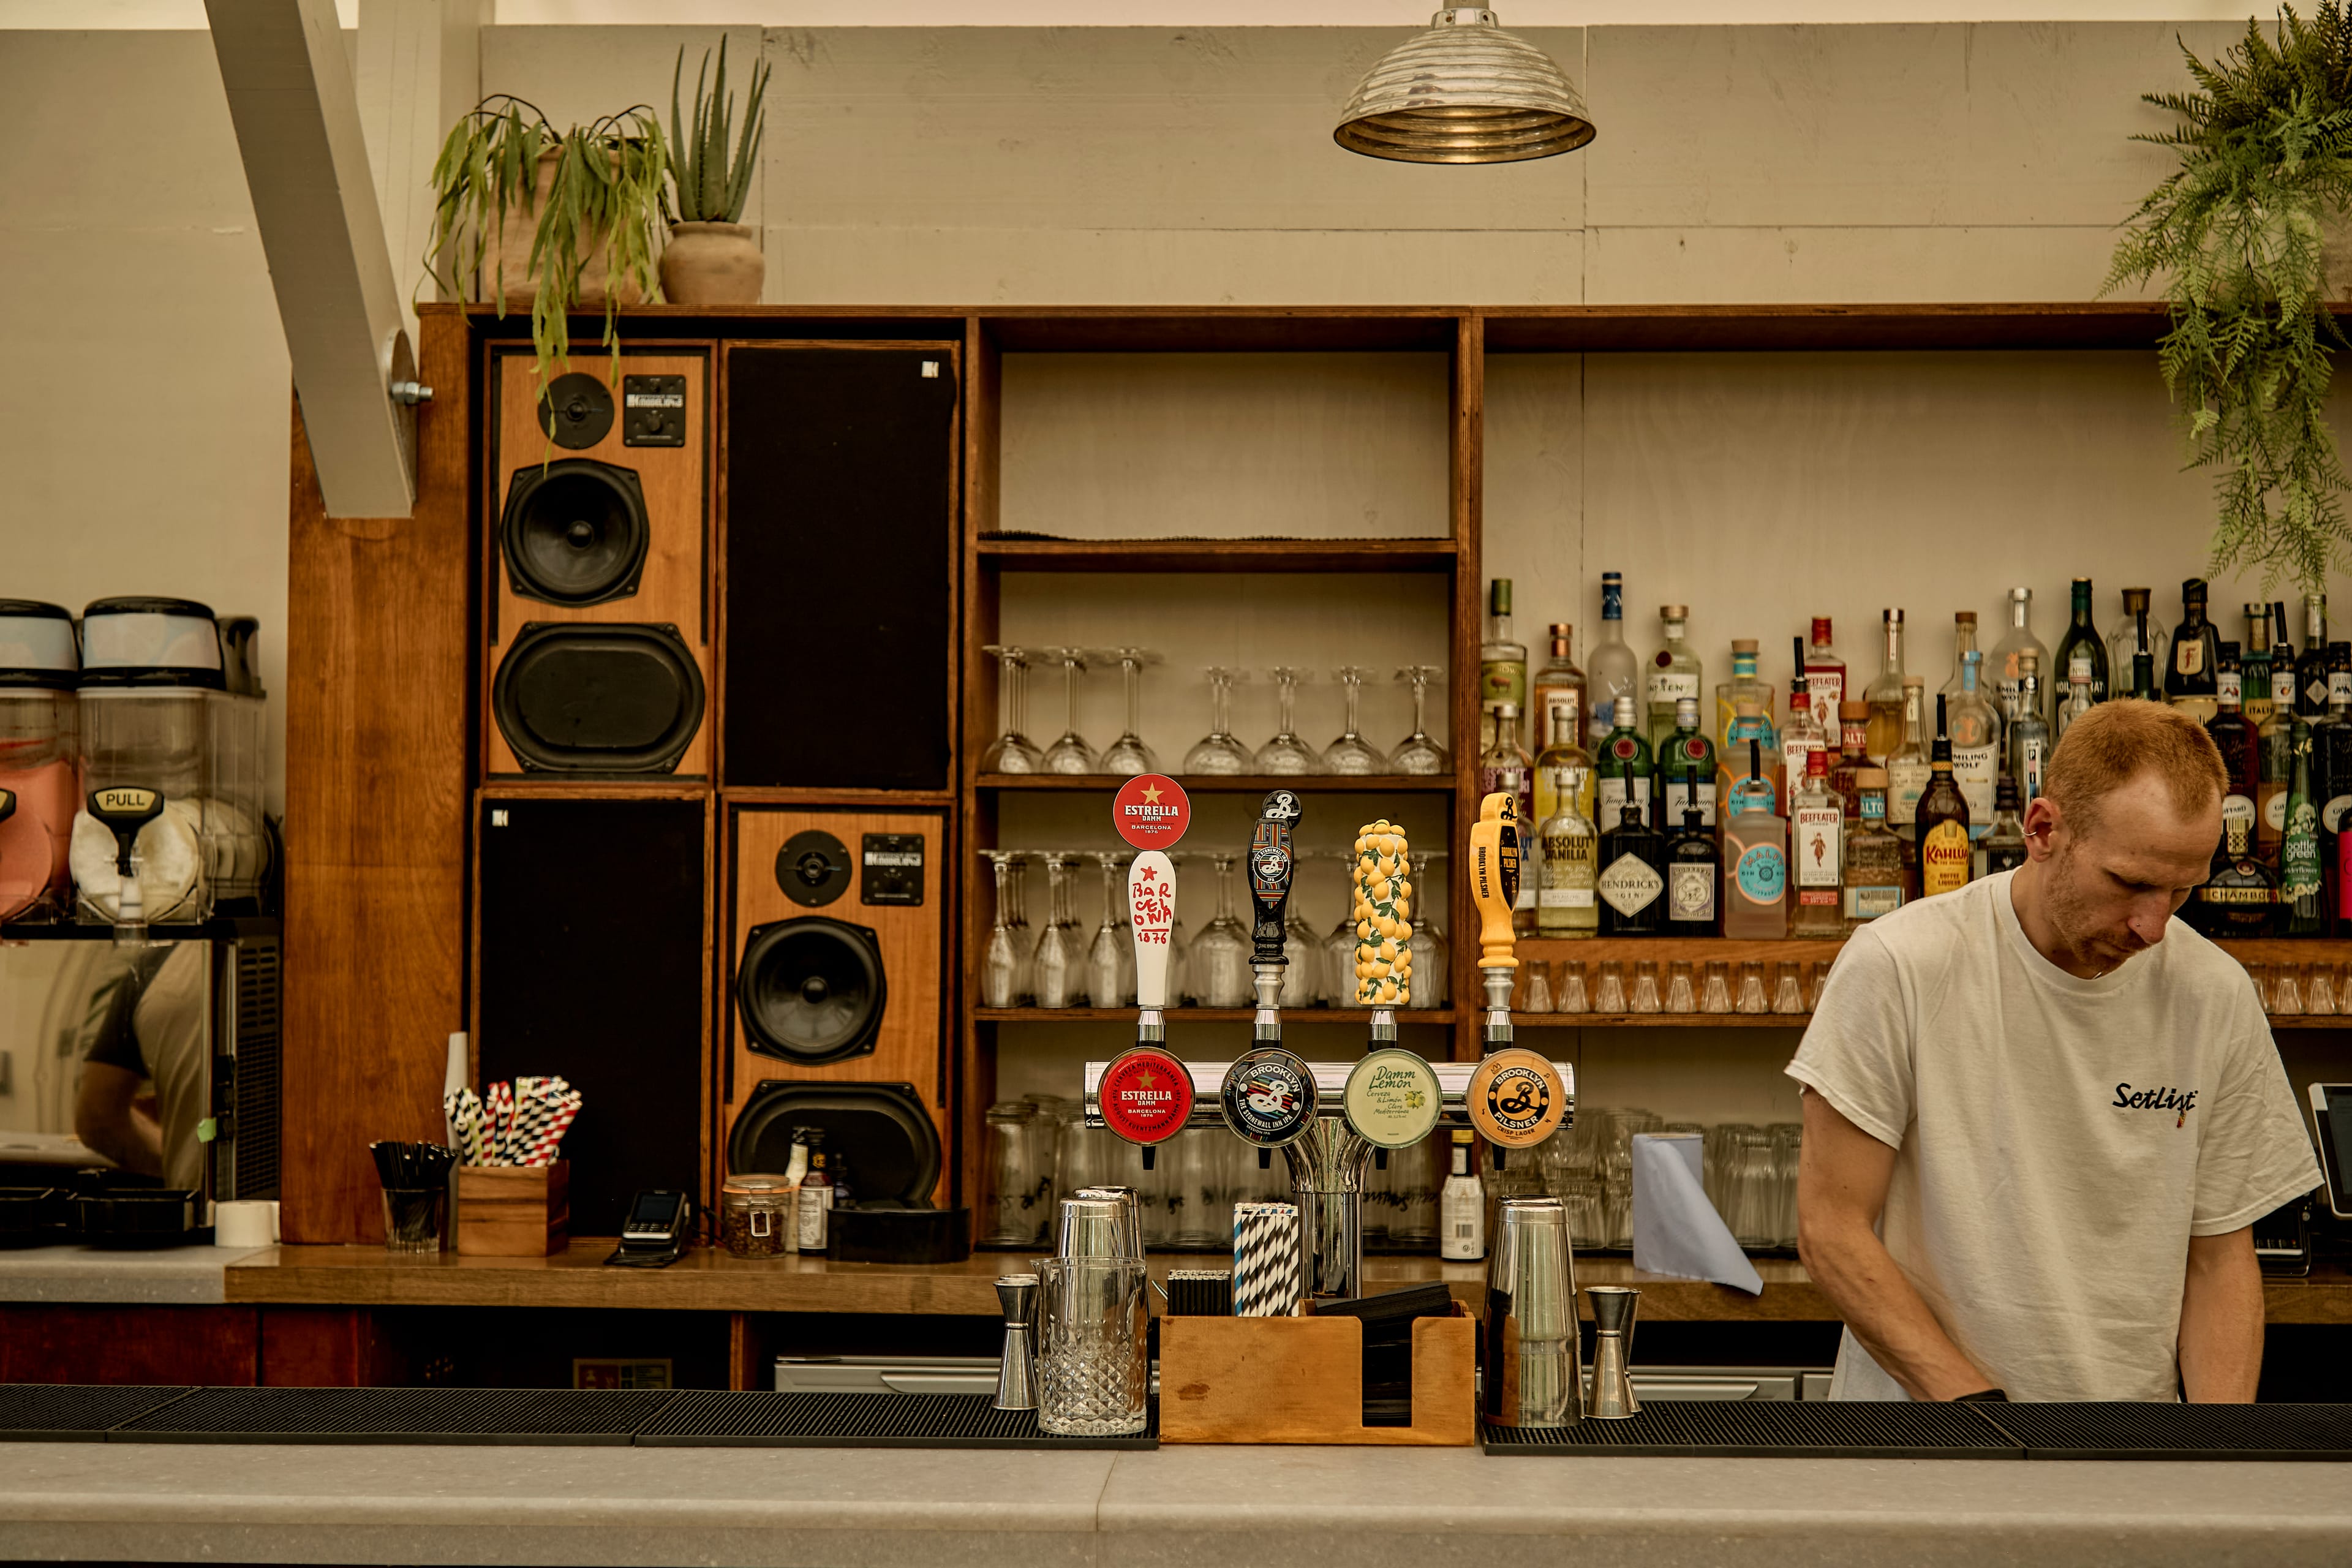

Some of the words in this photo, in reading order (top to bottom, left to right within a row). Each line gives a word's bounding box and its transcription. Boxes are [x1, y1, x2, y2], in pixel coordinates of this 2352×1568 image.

[1807, 677, 1840, 687] EEFEATER
[106, 793, 145, 806] PULL
[1125, 805, 1179, 816] ESTRELLA
[1800, 813, 1838, 824] BEEFEATER
[1542, 837, 1590, 849] ABSOLUT
[2286, 840, 2315, 851] bottle
[1501, 847, 1518, 857] BROOKLYN
[2286, 850, 2316, 862] green
[1504, 858, 1517, 869] PILSNER
[1479, 876, 1490, 899] PILSNER
[1602, 880, 1660, 889] HENDRICK'S
[1137, 932, 1166, 944] 1876
[1114, 1065, 1136, 1087] CERVEZA
[1250, 1065, 1300, 1093] BROOKLYN
[1376, 1066, 1415, 1080] Damm
[1495, 1069, 1545, 1089] BROOKLYN
[1368, 1075, 1411, 1090] Lemon
[1121, 1091, 1172, 1101] ESTRELLA
[1113, 1103, 1129, 1124] AUGUST
[1128, 1119, 1170, 1132] KUENTZMANN
[1169, 1104, 1181, 1121] DAMM
[1243, 1109, 1271, 1128] STONEWALL
[1273, 1119, 1283, 1128] INN
[1283, 1114, 1293, 1124] IPA
[1494, 1112, 1539, 1128] PILSNER
[1246, 1125, 1263, 1134] SESSION
[1497, 1126, 1513, 1135] CRISP
